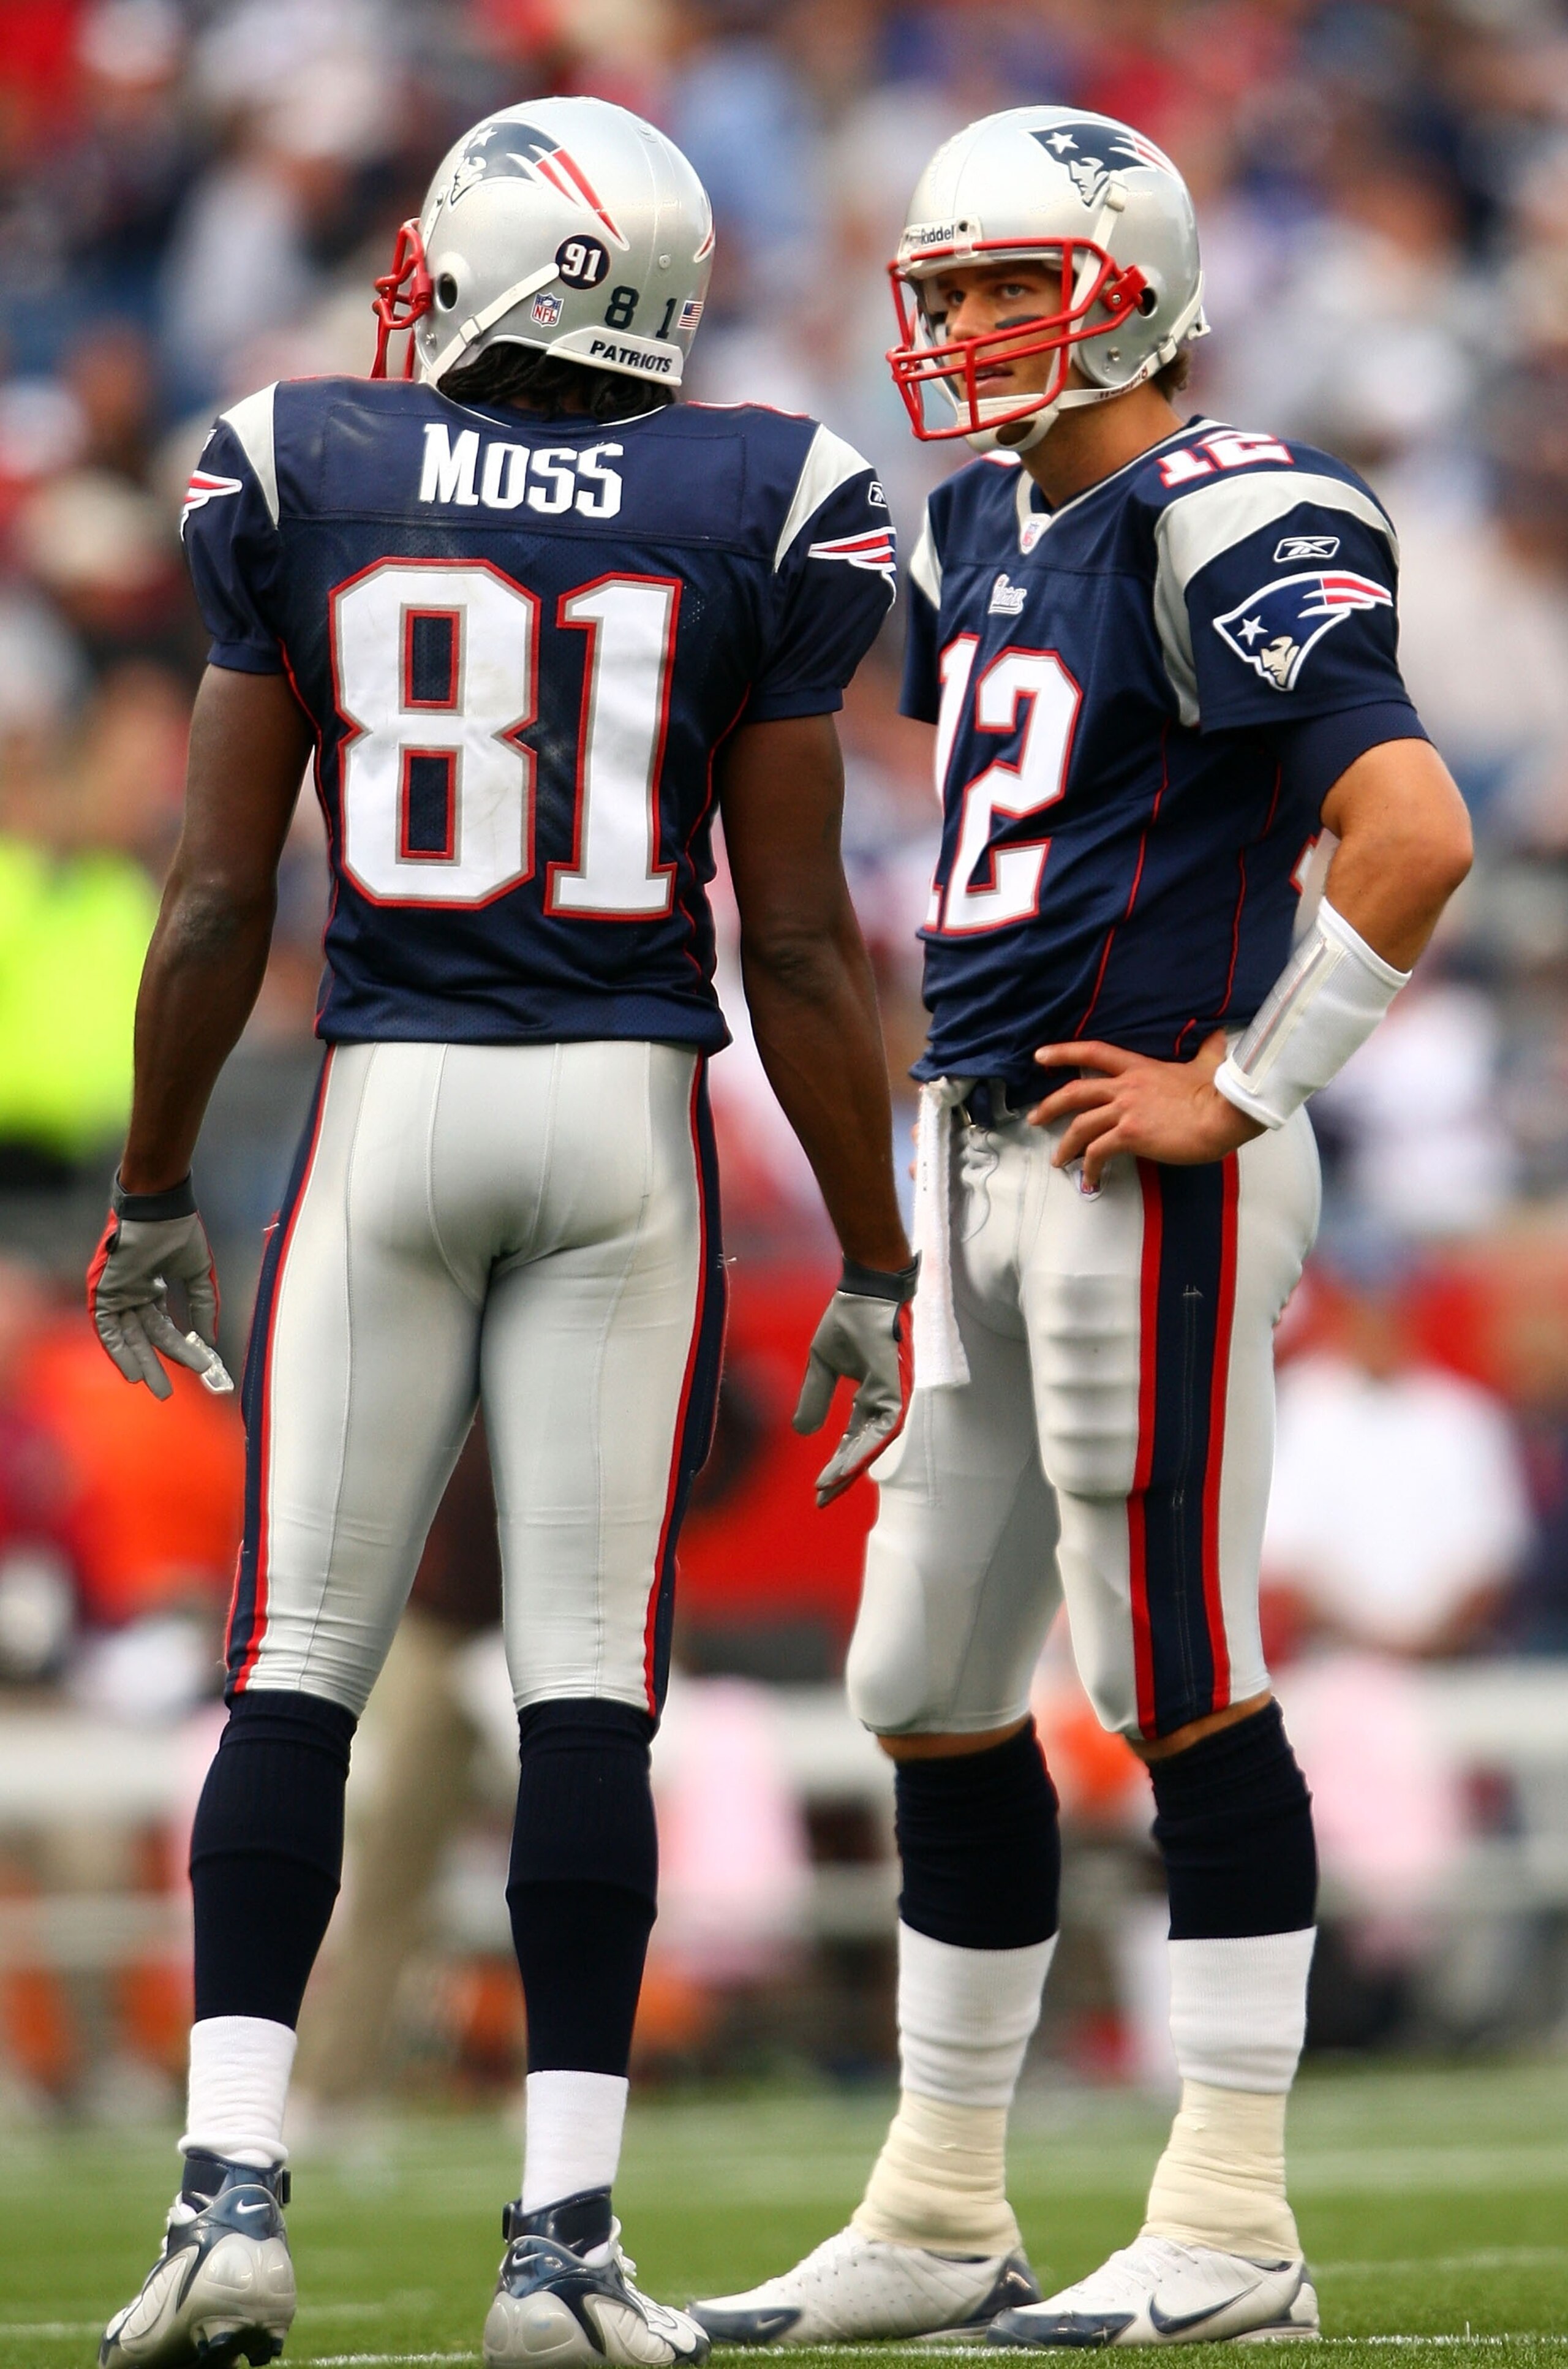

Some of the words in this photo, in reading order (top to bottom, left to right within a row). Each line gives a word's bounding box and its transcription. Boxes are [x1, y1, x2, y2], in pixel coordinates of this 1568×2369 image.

[921, 224, 955, 245] Riddel
[561, 242, 601, 282] 91
[533, 305, 556, 322] NFL
[589, 339, 673, 373] PATRIOTS
[1156, 429, 1294, 488] 12
[328, 557, 684, 923] 81
[923, 632, 1084, 936] 12
